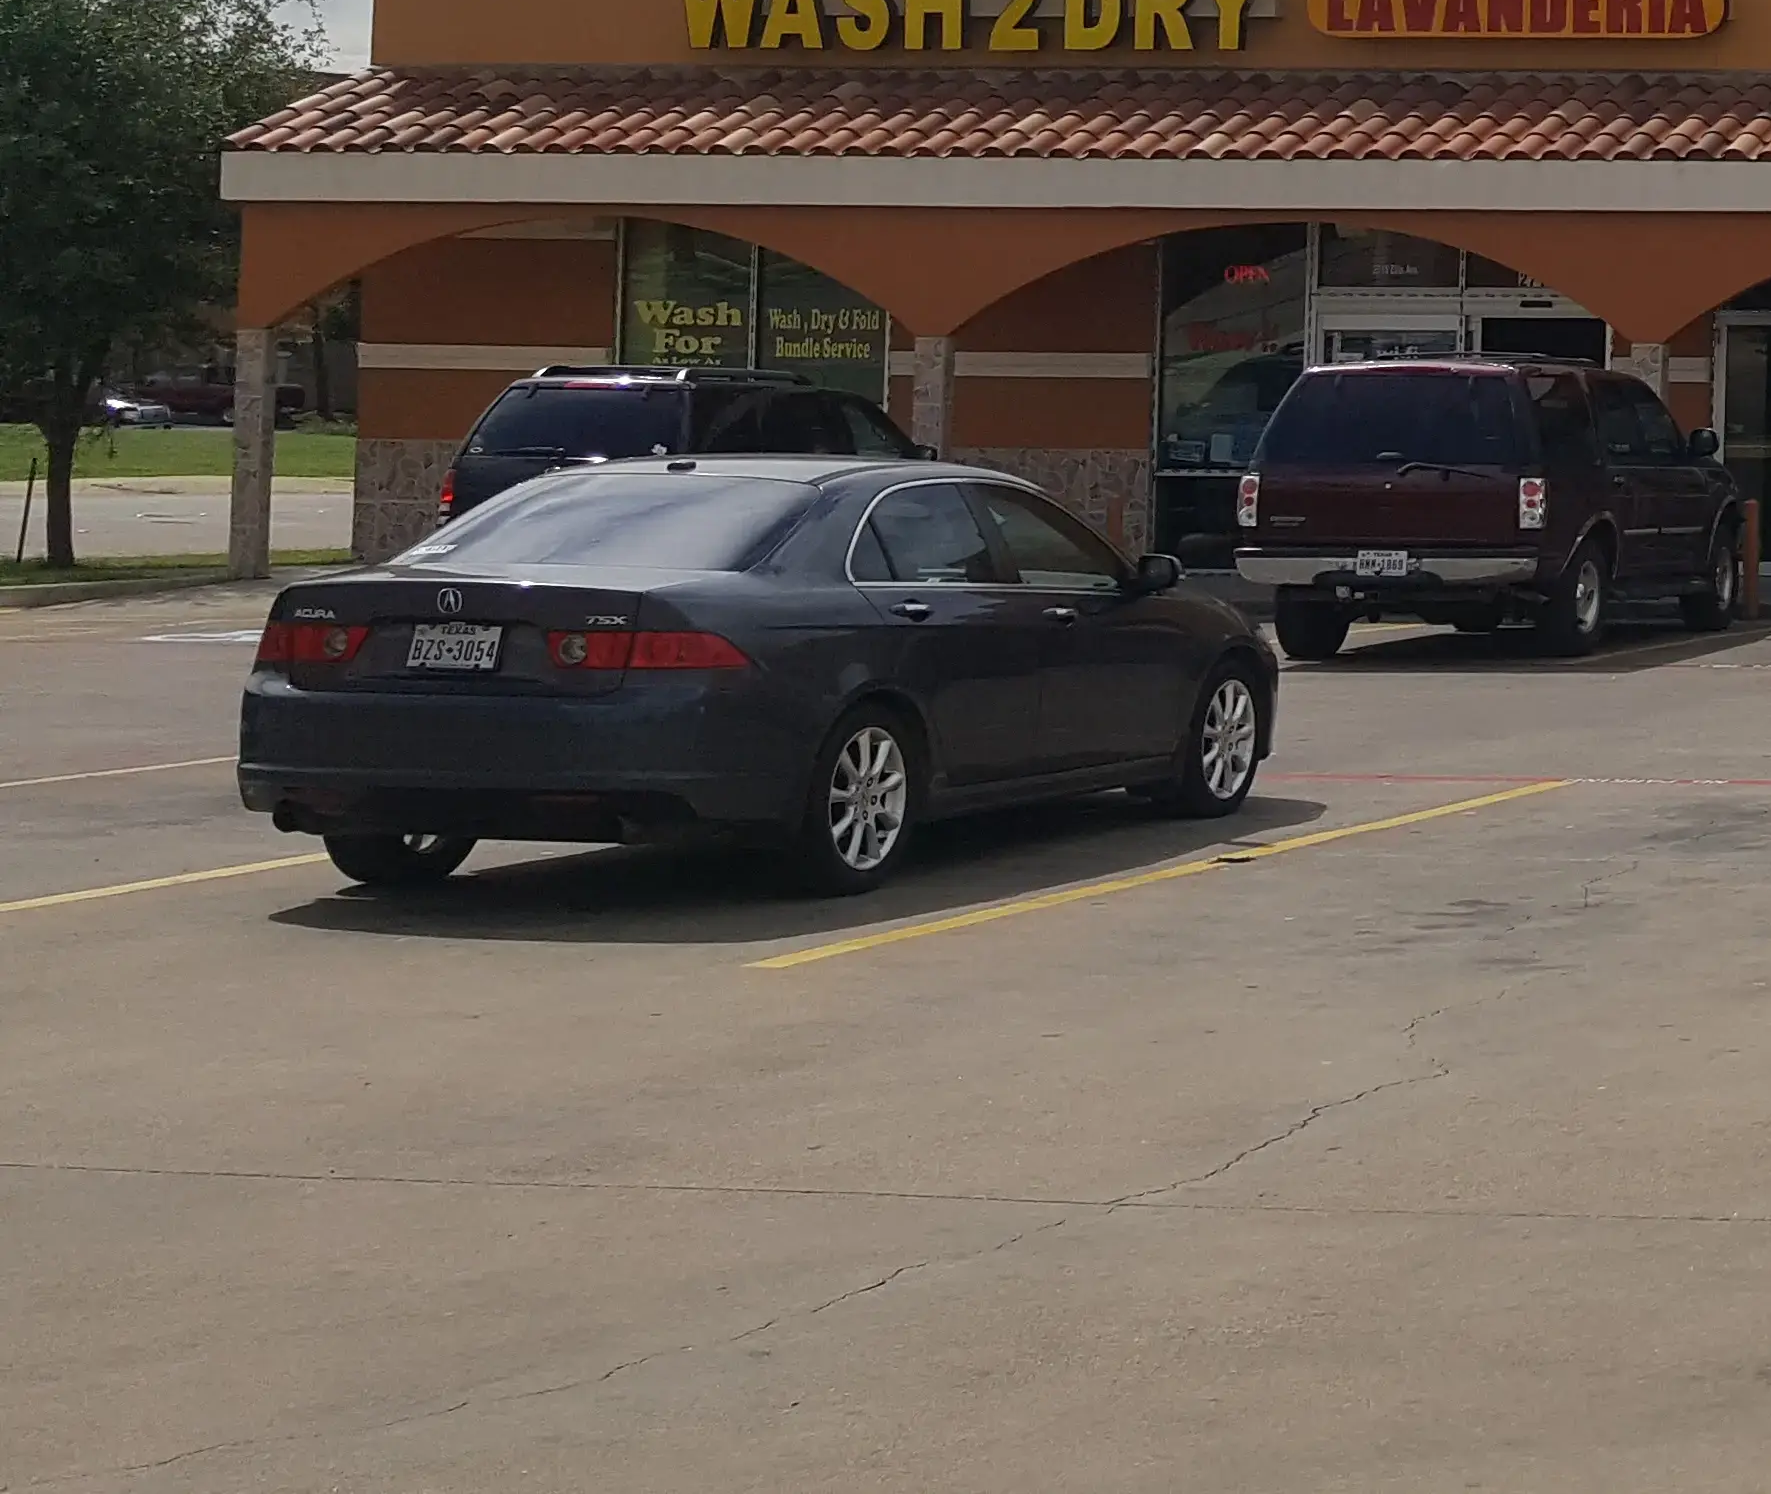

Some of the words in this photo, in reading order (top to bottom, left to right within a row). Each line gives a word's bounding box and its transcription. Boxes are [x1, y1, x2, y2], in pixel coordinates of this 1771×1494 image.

[633, 300, 742, 327] Wash
[811, 309, 835, 334] Dry
[838, 309, 851, 330] &
[852, 309, 880, 330] Fold
[652, 328, 723, 354] For
[775, 337, 820, 358] Bundle
[823, 338, 871, 359] Service
[295, 608, 336, 619] ACURA
[586, 615, 628, 625] TSX
[440, 623, 477, 635] TEXAS
